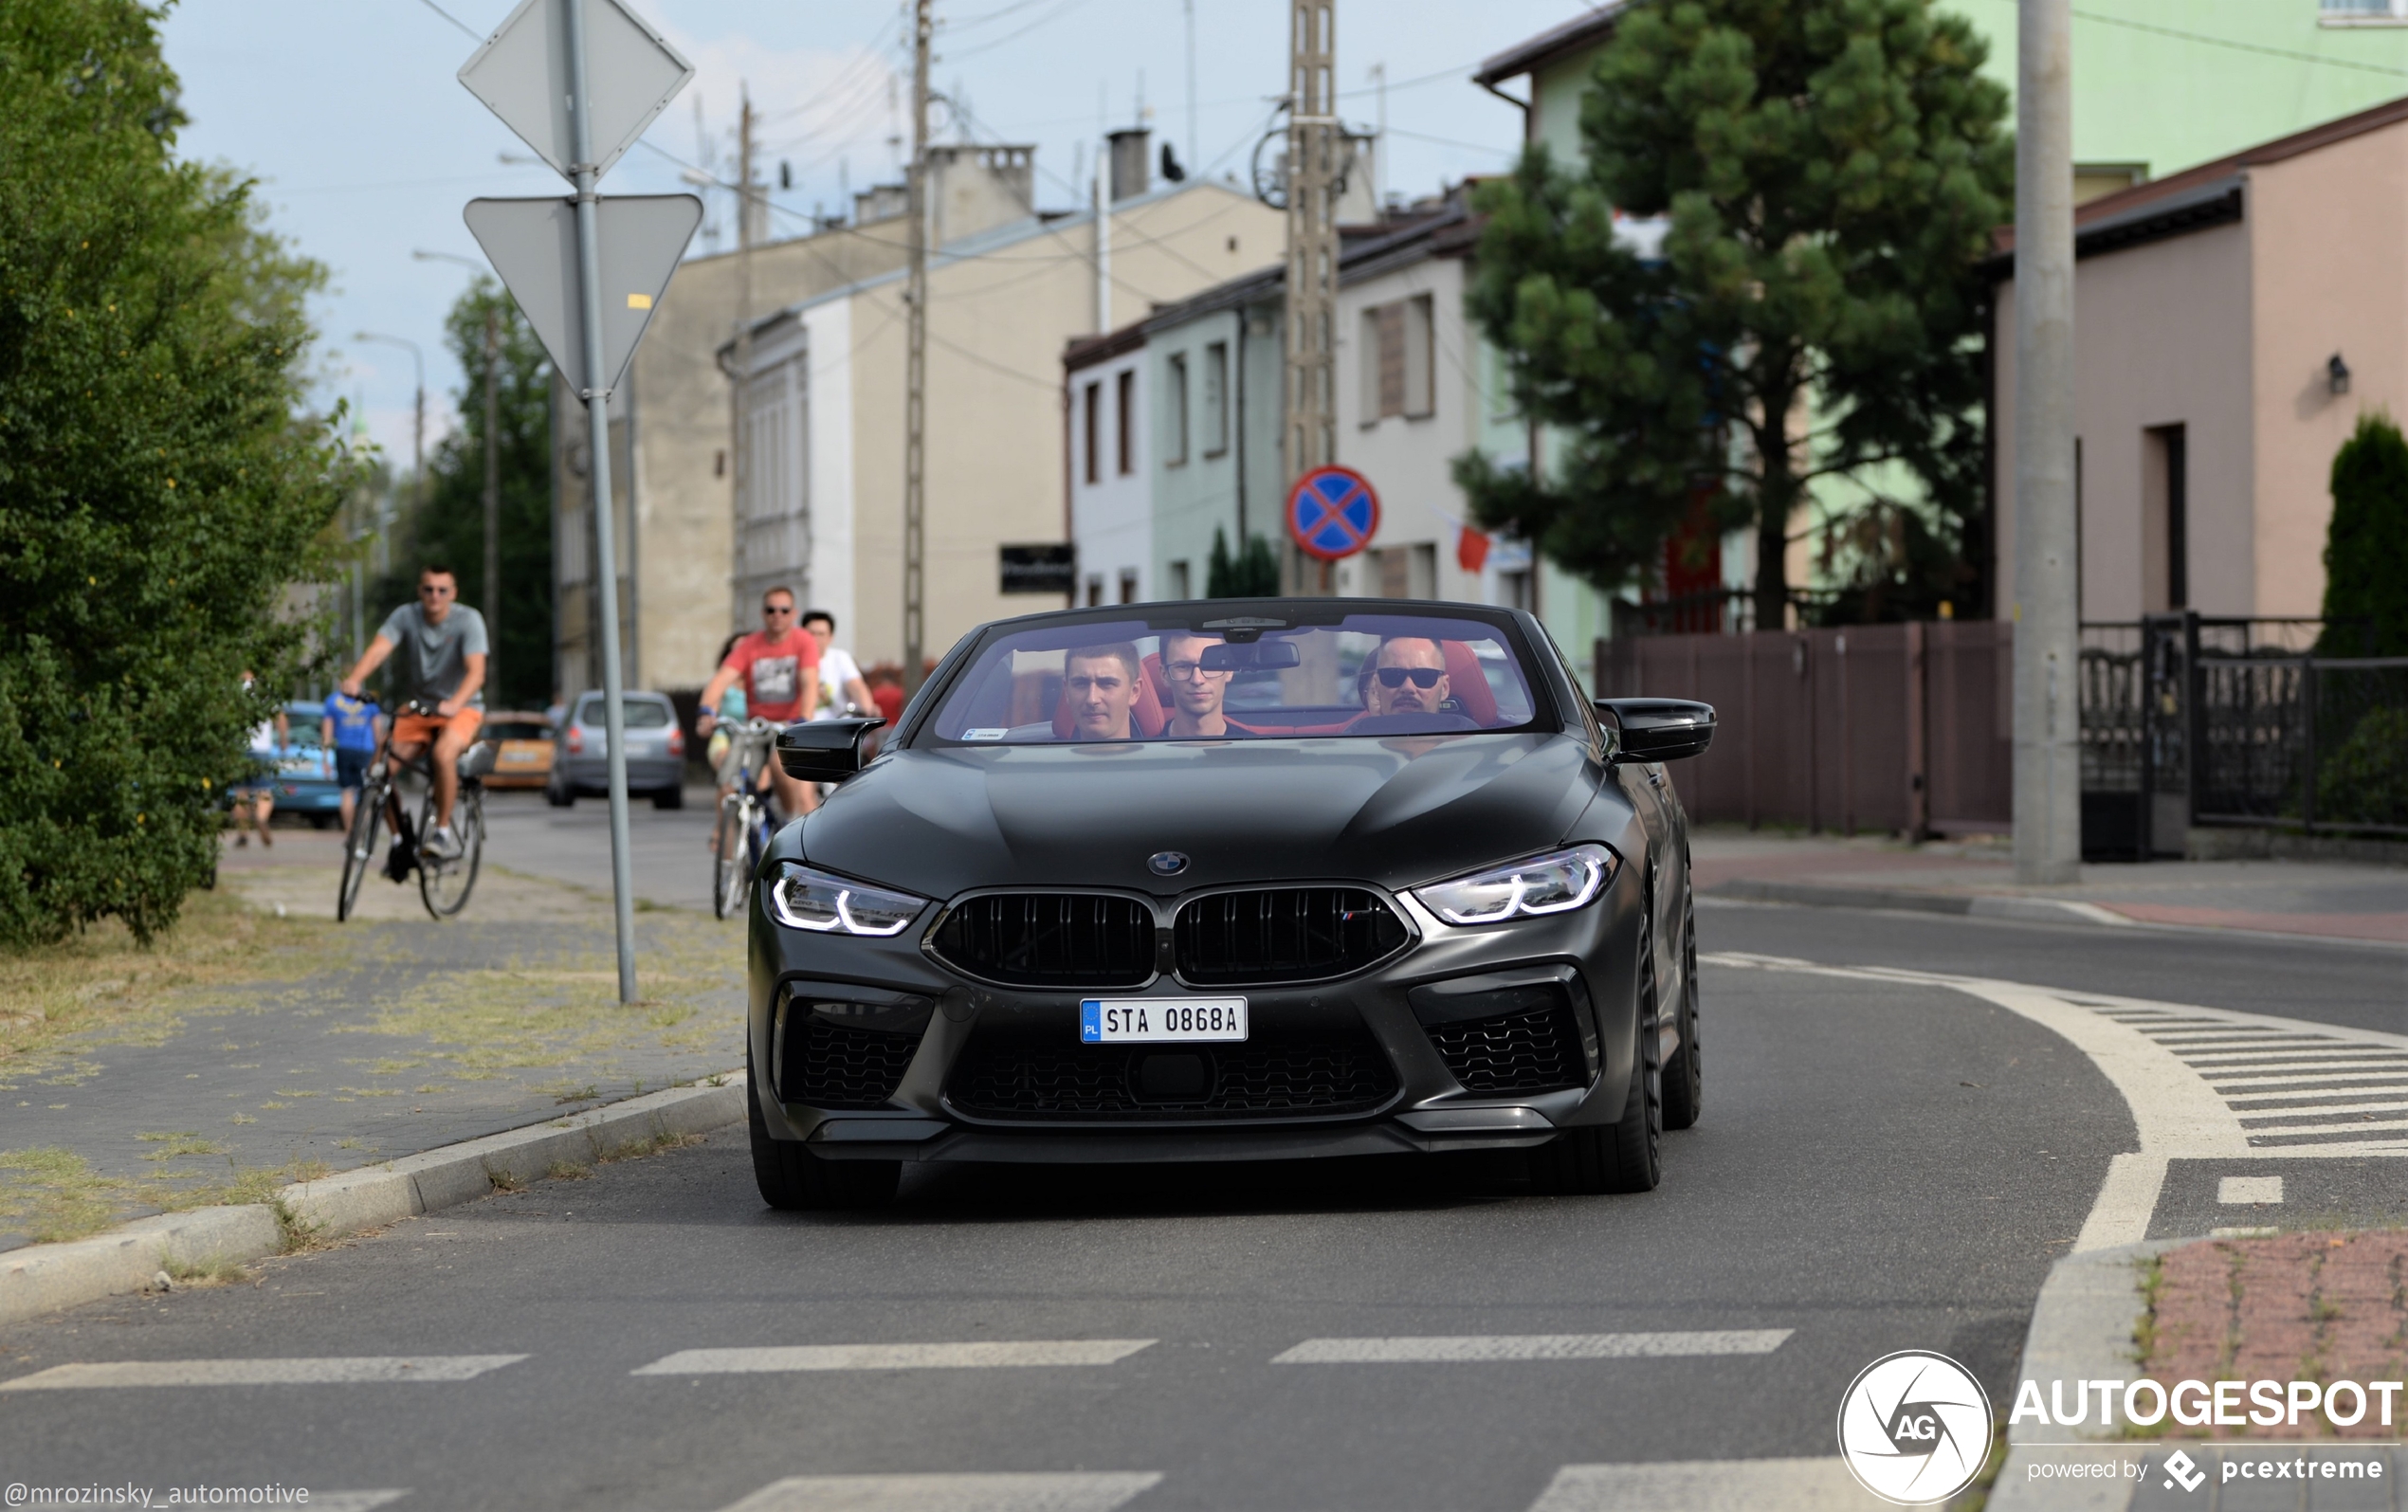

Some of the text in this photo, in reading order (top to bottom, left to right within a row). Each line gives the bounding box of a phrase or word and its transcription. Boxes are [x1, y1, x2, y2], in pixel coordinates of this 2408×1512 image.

[1107, 1008, 1237, 1032] STA 0868A
[1085, 1026, 1098, 1034] PL
